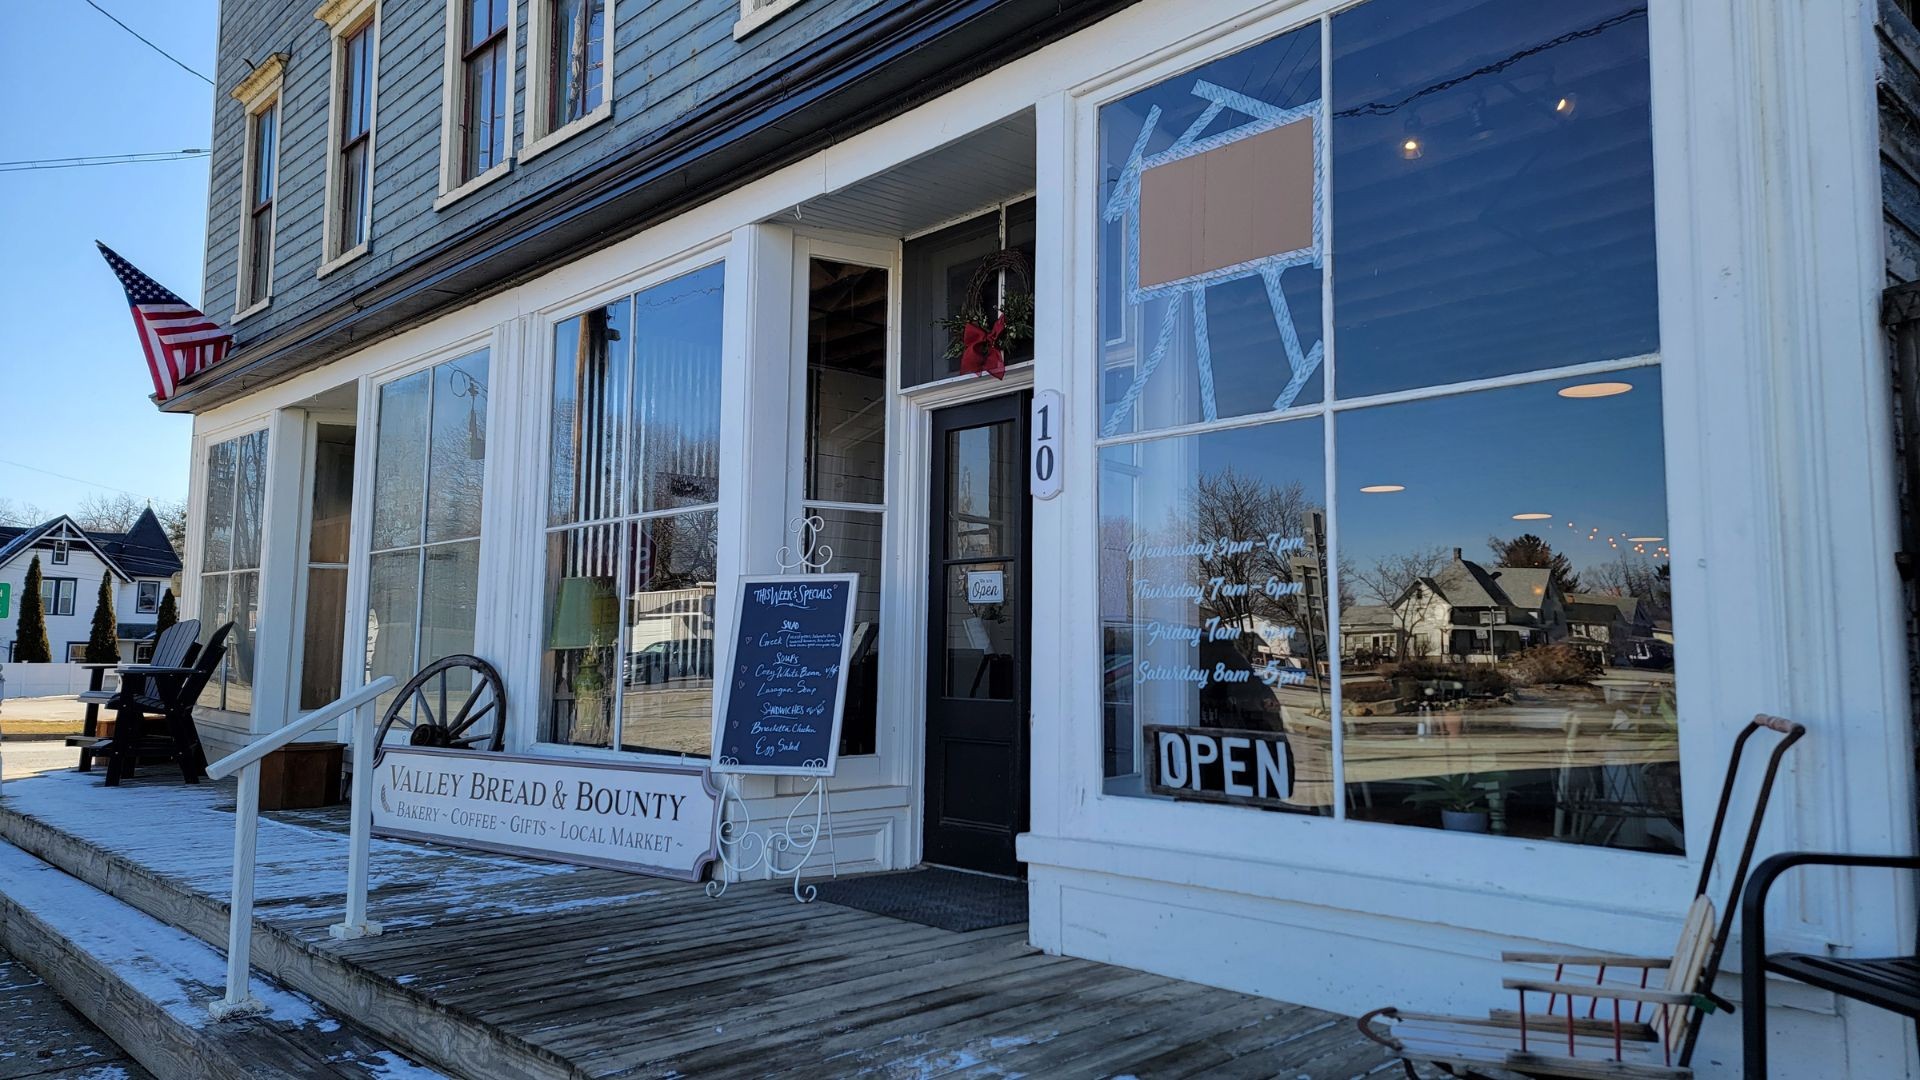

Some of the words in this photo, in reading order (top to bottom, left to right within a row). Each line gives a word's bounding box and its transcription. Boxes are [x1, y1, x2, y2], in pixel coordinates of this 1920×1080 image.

[1126, 539, 1215, 561] Wednesday
[796, 585, 832, 605] SPECIALS
[972, 581, 999, 599] Open
[1133, 579, 1205, 605] Thursday
[759, 633, 782, 648] Greek
[1146, 621, 1202, 647] Friday
[776, 666, 798, 678] White
[800, 666, 821, 678] Bean
[1136, 661, 1210, 689] Saturday
[797, 680, 817, 695] Soup
[760, 702, 804, 715] SANDWICHES
[792, 722, 816, 733] Chicken
[755, 736, 775, 757] Egg
[778, 738, 800, 752] Salad
[1158, 731, 1290, 801] OPEN
[390, 764, 465, 798] VALLEY
[470, 772, 547, 807] BREAD
[552, 780, 568, 810] &
[575, 781, 687, 822] BOUNTY
[396, 801, 439, 822] BAKERY
[450, 807, 497, 831] COFFEE
[510, 815, 547, 836] GIFTS
[560, 821, 605, 844] LOCAL
[609, 827, 673, 853] MARKET
